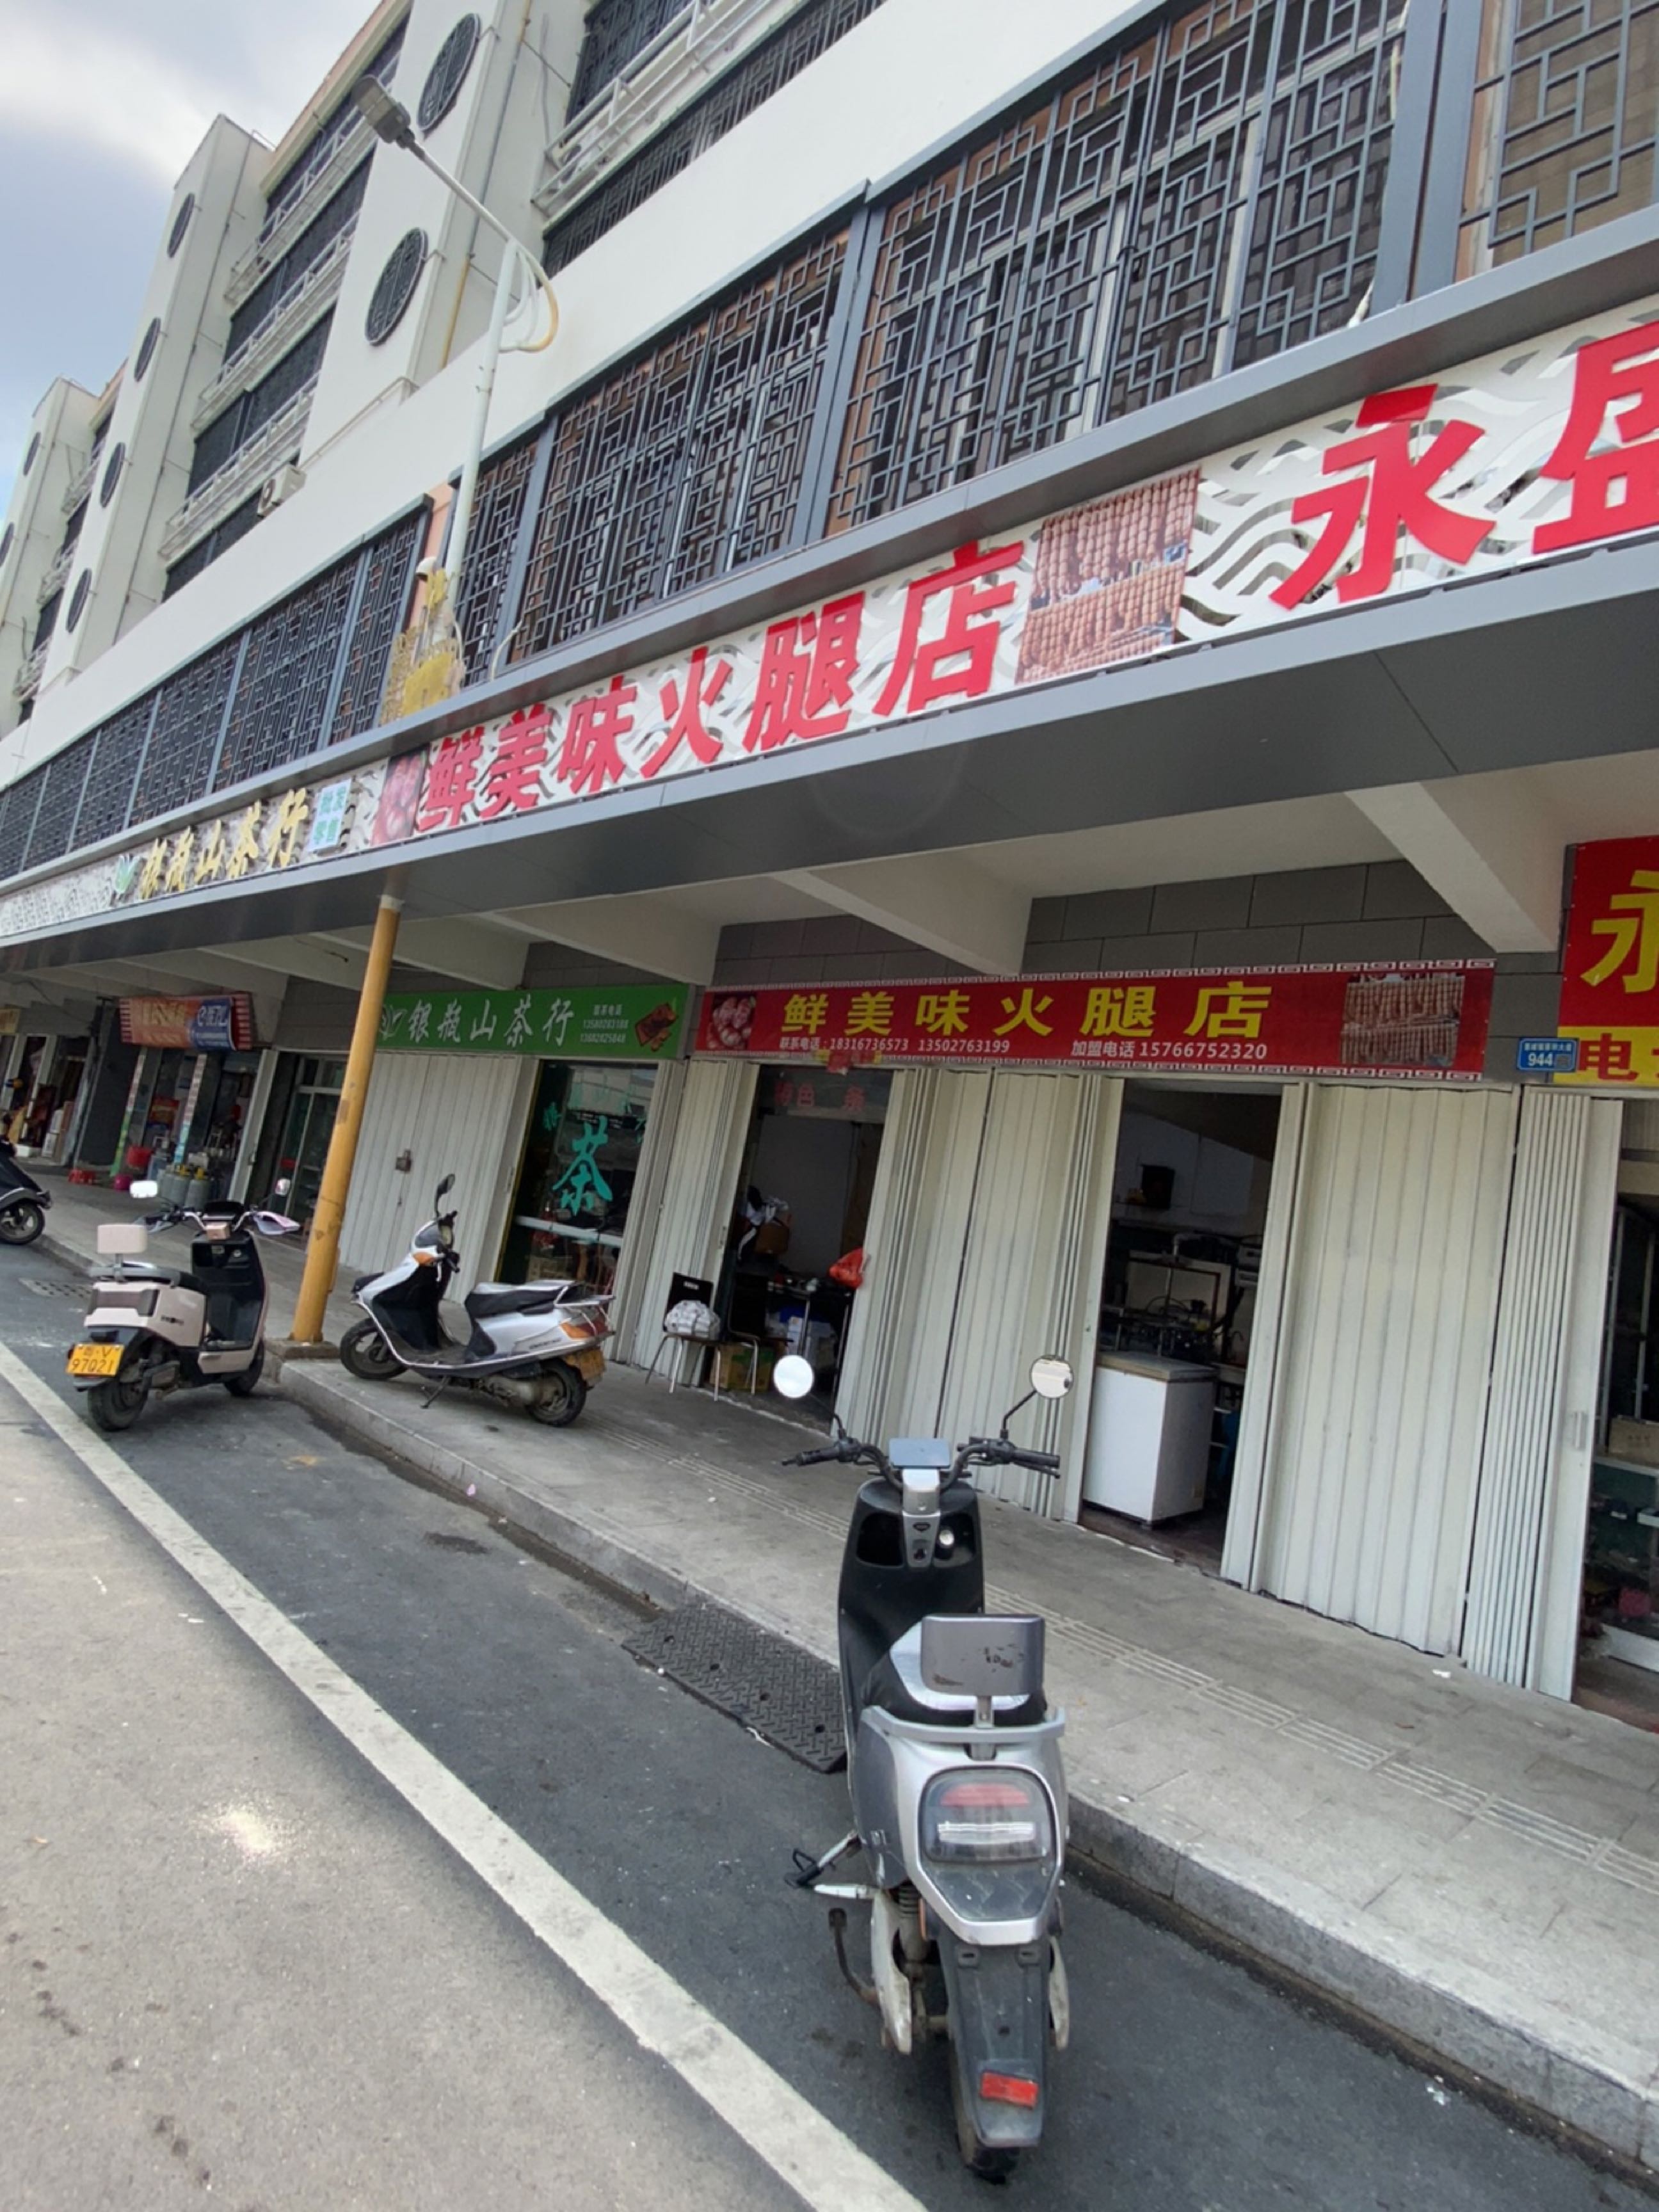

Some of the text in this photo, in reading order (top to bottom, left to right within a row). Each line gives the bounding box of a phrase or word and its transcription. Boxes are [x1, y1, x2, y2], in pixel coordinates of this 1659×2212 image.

[419, 540, 1023, 832] 鲜美味火腿店
[781, 981, 1272, 1037] 鲜美味火腿店
[918, 1039, 1010, 1053] 13502763199
[1528, 1053, 1553, 1066] 944
[1578, 1033, 1659, 1080] 电
[553, 1115, 613, 1216] 茶
